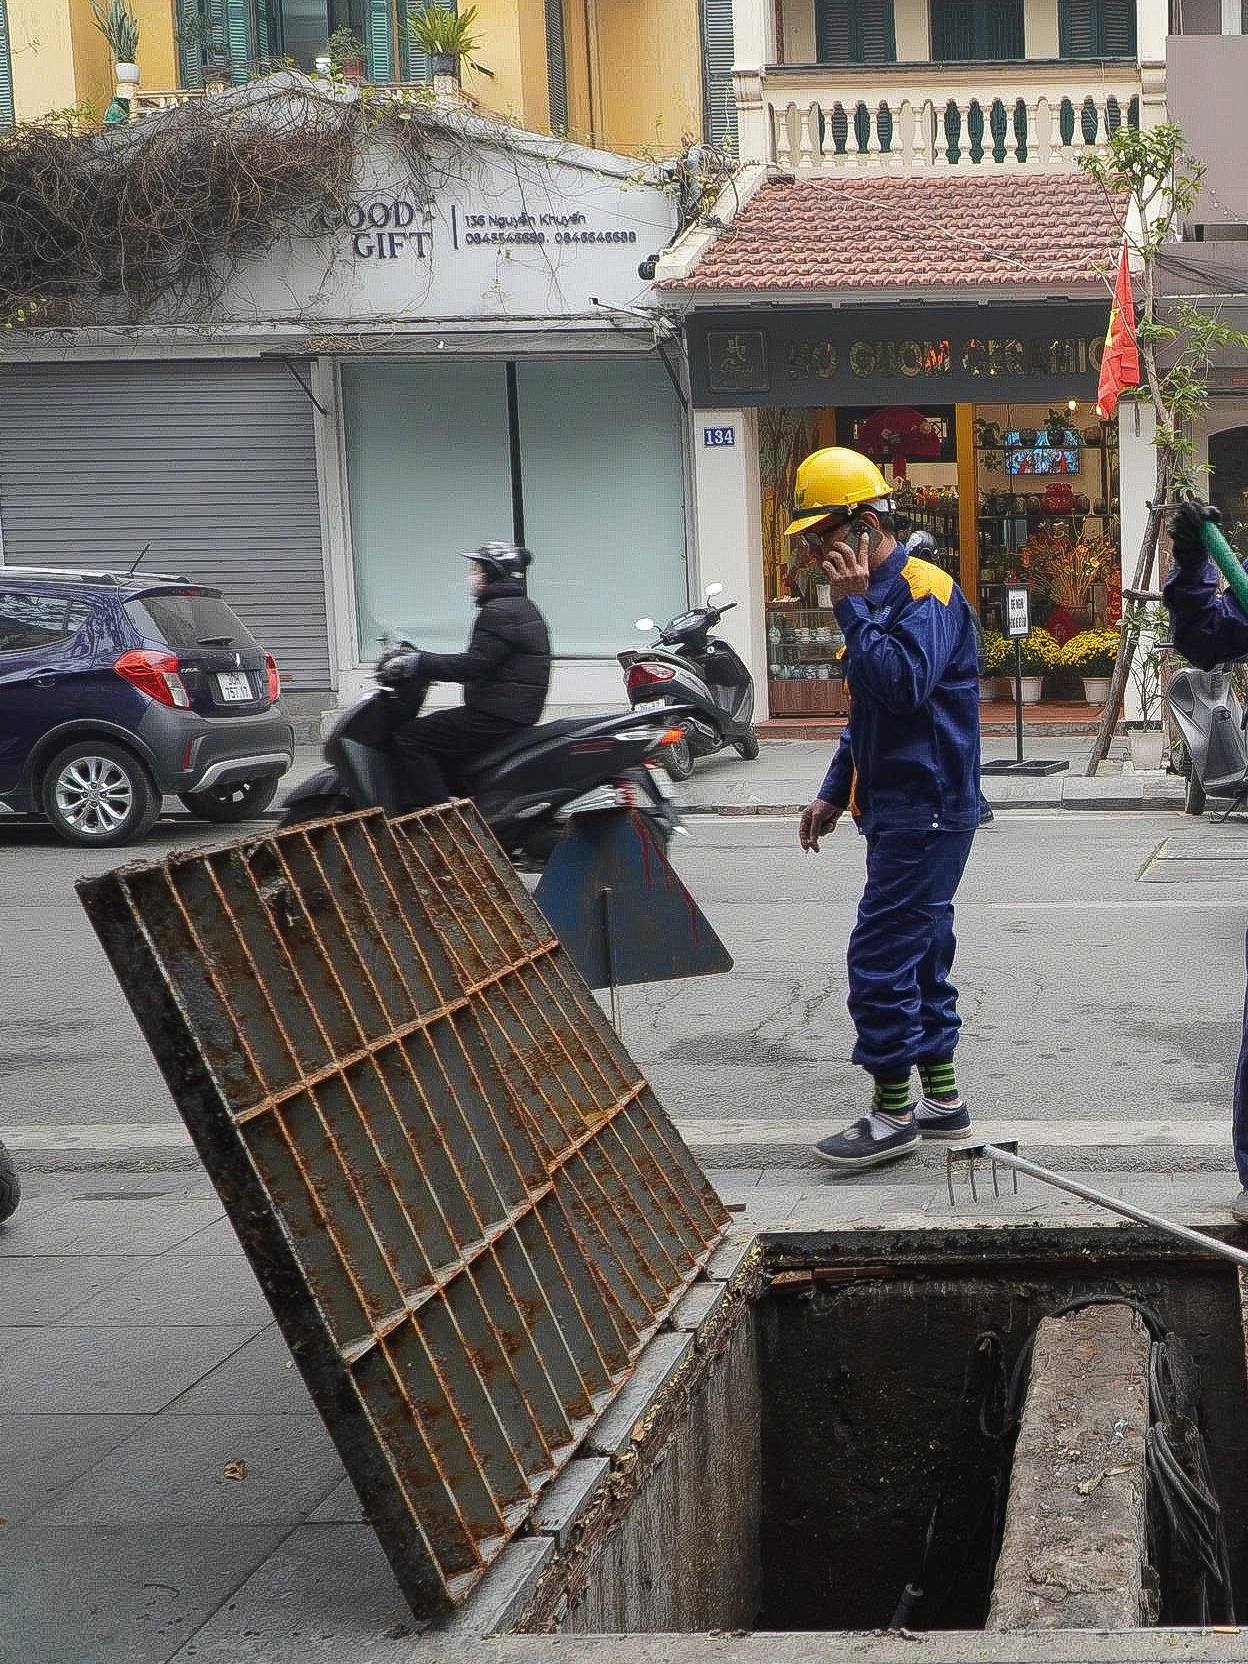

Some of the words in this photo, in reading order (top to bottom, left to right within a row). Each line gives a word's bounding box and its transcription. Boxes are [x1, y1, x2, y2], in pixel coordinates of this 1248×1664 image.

[465, 215, 486, 227] 136
[353, 232, 431, 258] GIFT
[706, 429, 734, 445] 134
